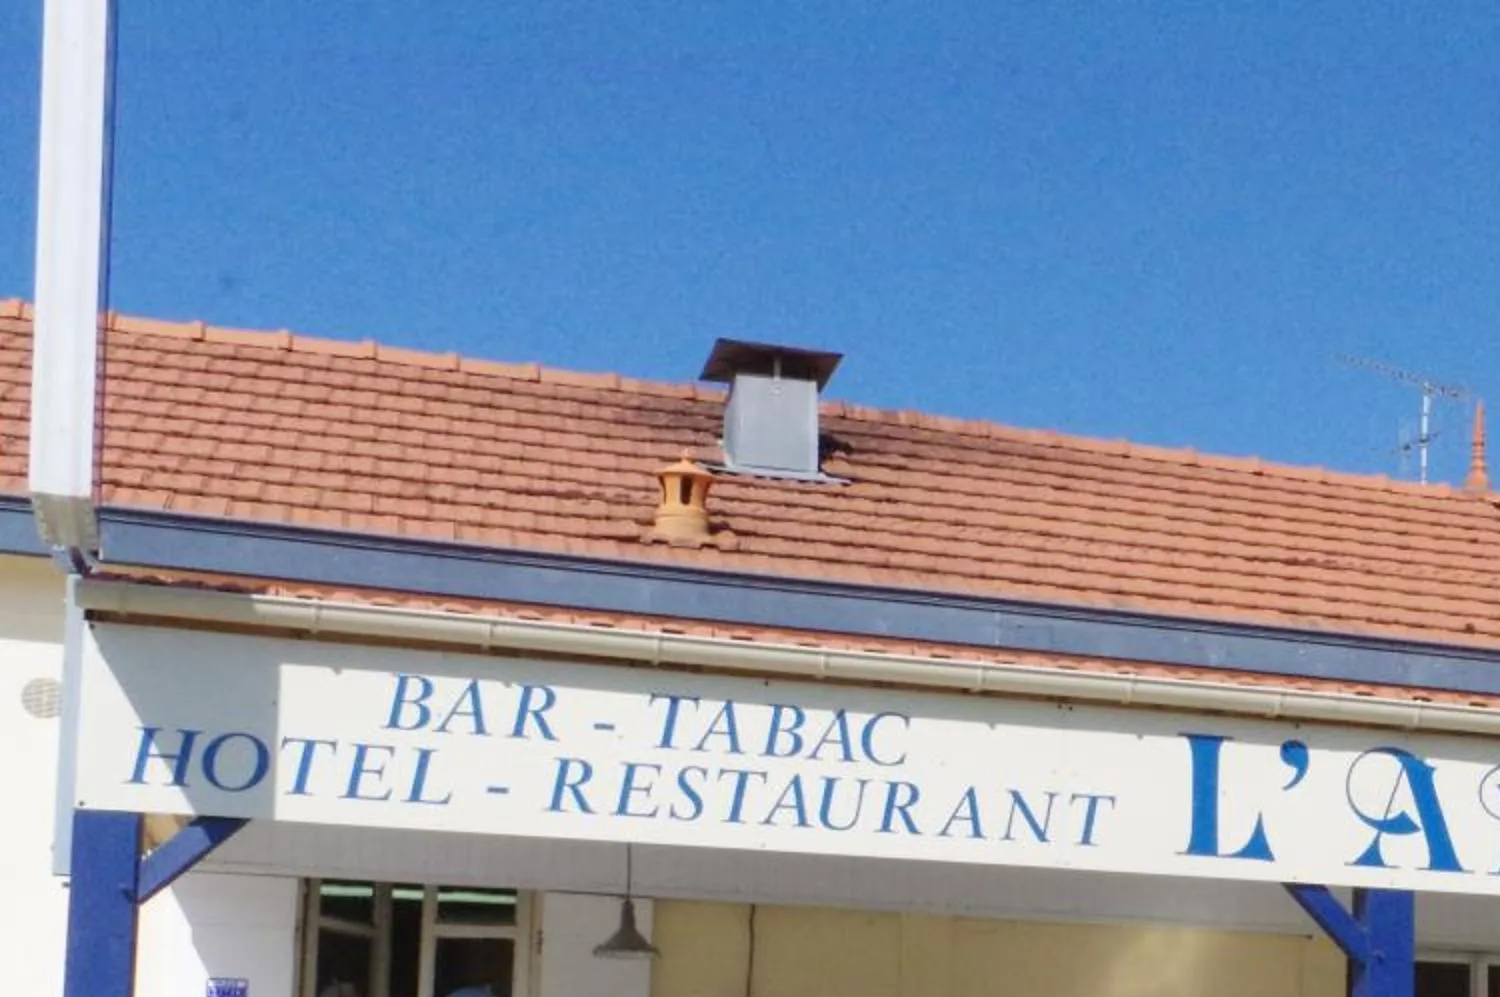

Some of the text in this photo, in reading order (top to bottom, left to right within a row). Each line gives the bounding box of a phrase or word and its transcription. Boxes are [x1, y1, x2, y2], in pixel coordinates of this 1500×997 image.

[381, 671, 559, 741] BAR
[647, 692, 912, 768] TABAC
[123, 722, 453, 806] HOTEL
[546, 756, 1119, 848] RESTAURANT
